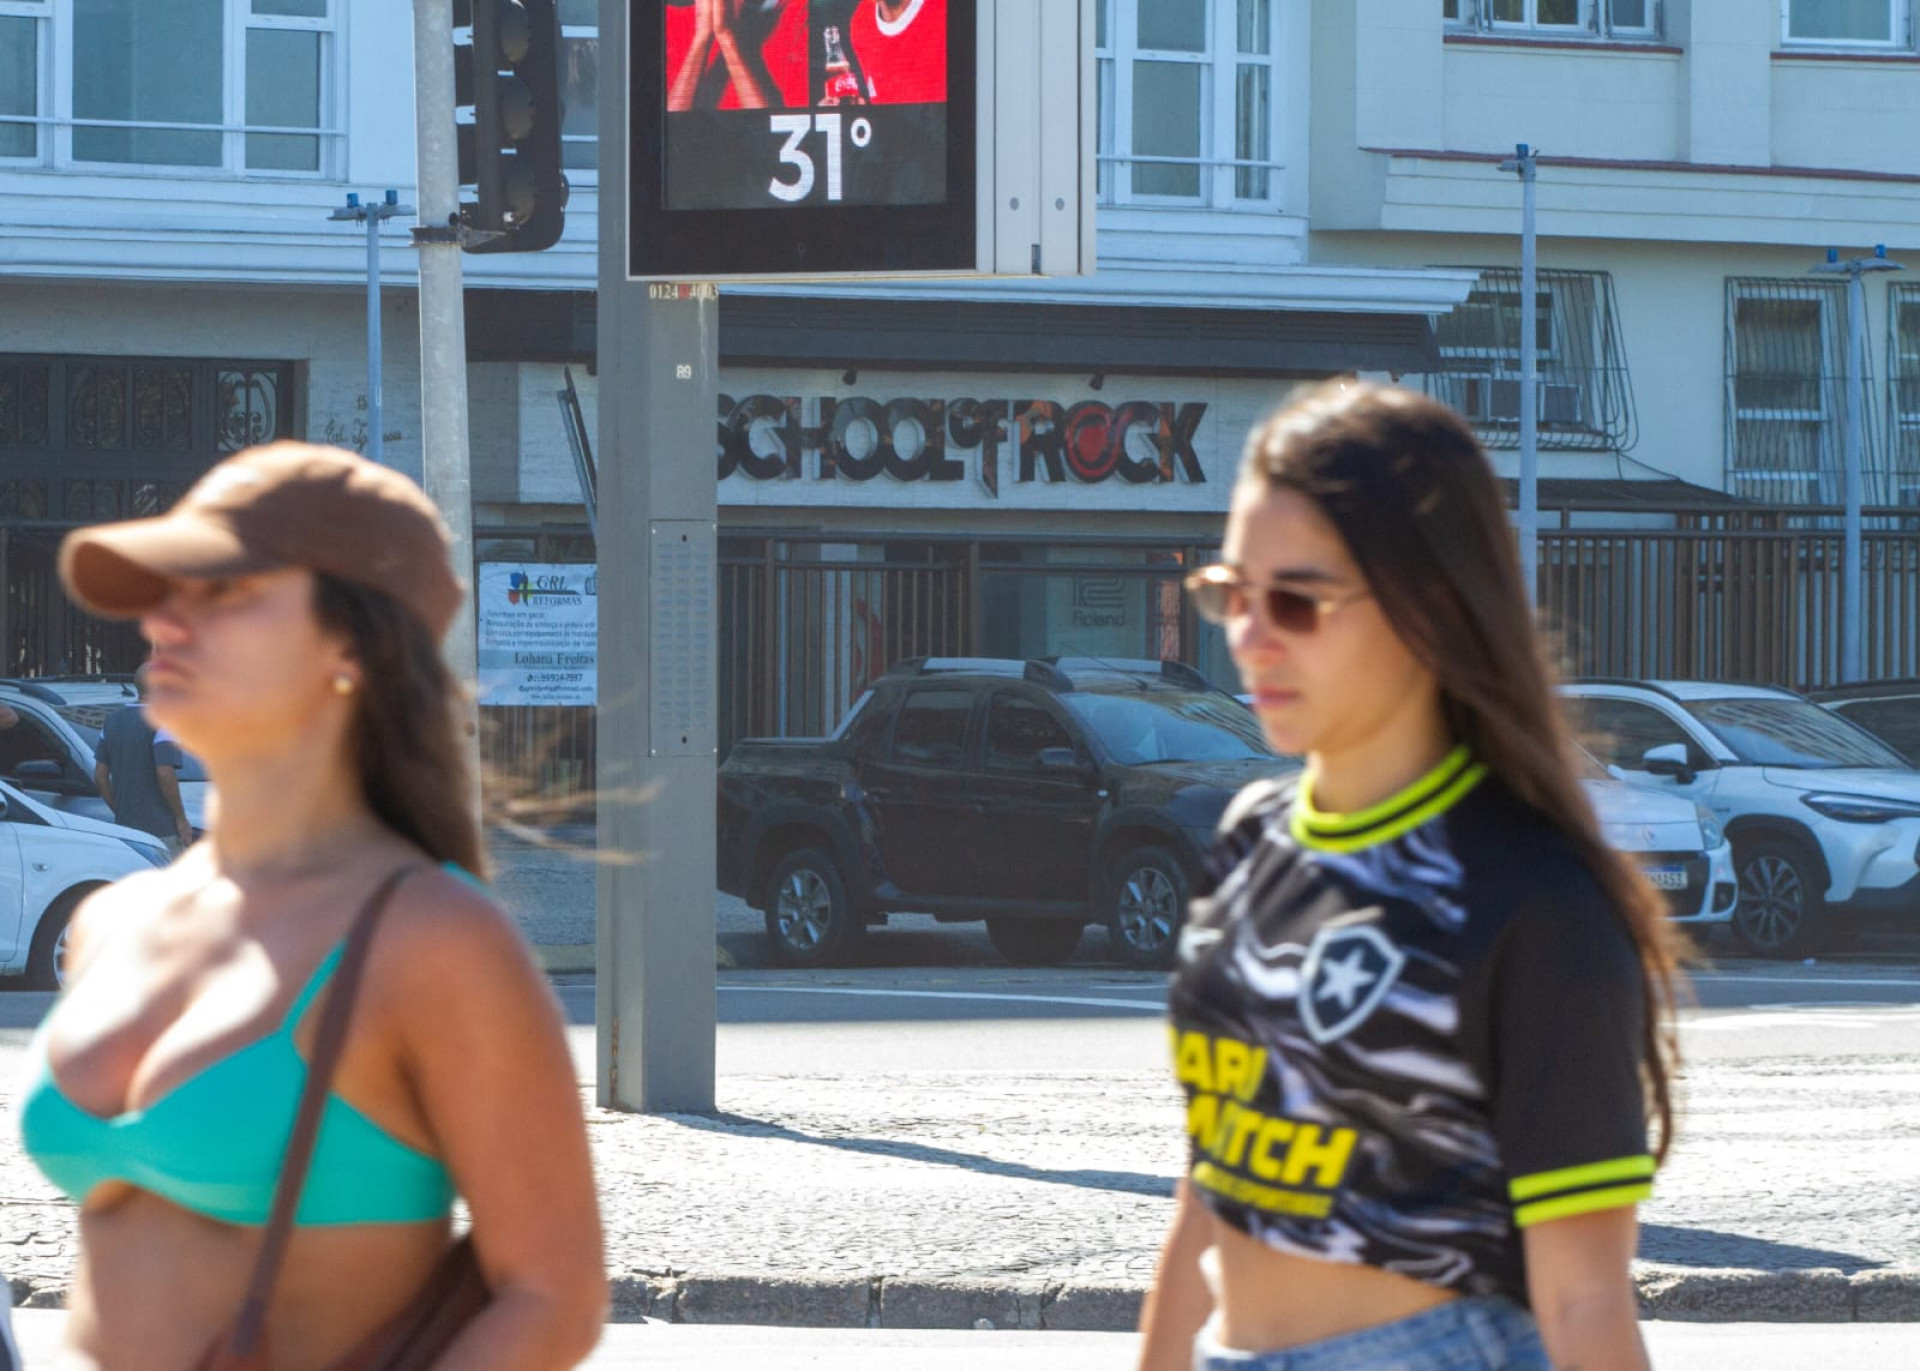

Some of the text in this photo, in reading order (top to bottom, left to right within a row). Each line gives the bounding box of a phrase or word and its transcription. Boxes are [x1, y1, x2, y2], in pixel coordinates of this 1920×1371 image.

[769, 113, 872, 201] 31°
[1013, 397, 1207, 484] ROCK
[533, 596, 583, 606] REFORMAS
[537, 575, 568, 590] GRL
[557, 652, 595, 664] Freitas
[1168, 1025, 1268, 1102] ARI
